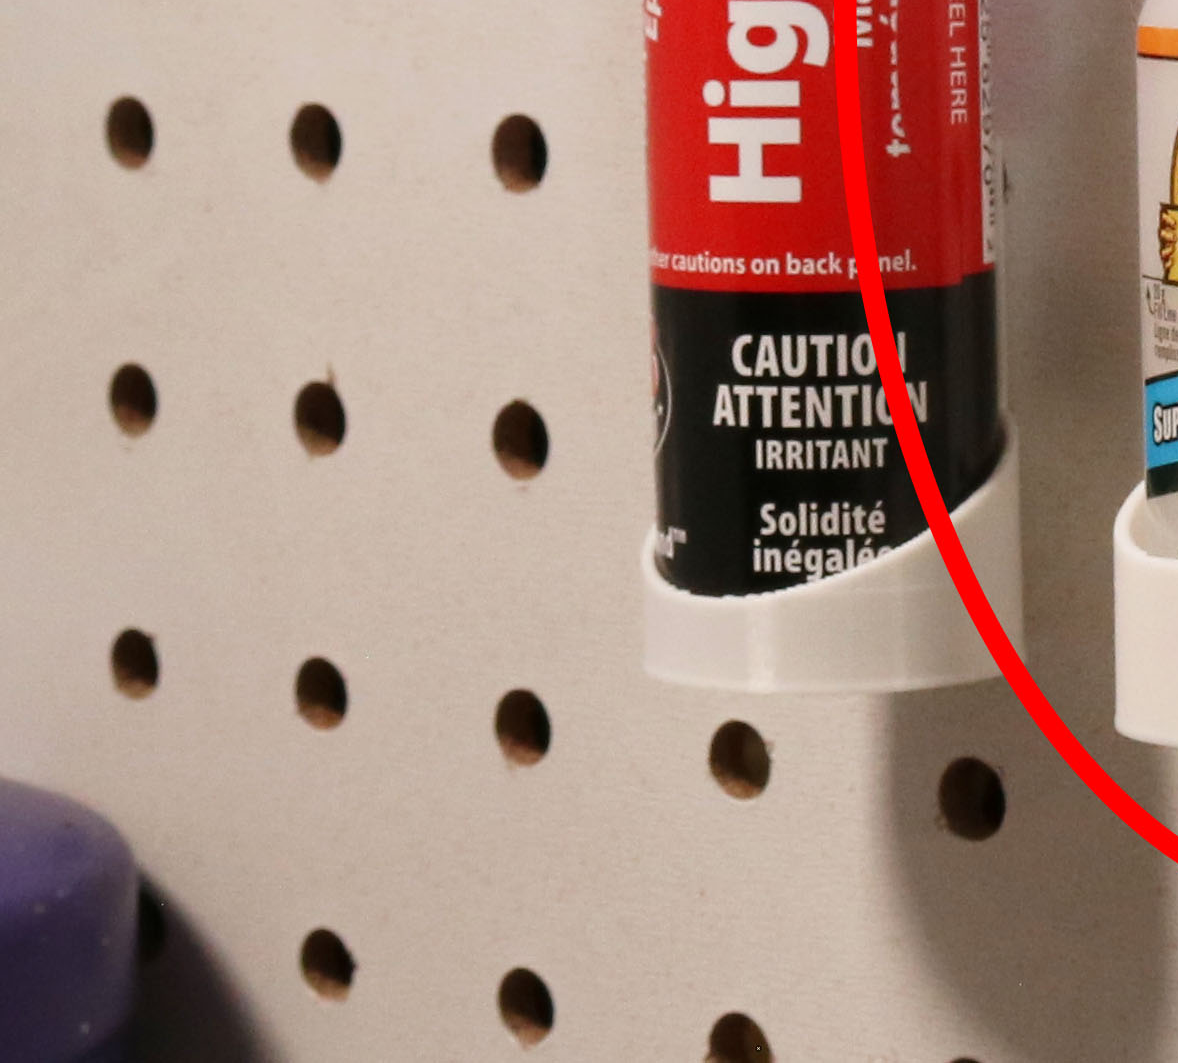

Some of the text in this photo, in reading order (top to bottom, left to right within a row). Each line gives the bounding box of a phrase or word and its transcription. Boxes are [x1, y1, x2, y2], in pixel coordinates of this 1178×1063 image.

[950, 46, 968, 124] HERE
[672, 250, 745, 275] cautions
[750, 255, 780, 275] on
[785, 252, 842, 275] back
[848, 248, 917, 280] pnel.
[755, 437, 888, 470] IRRITANT
[760, 500, 886, 536] Solidité
